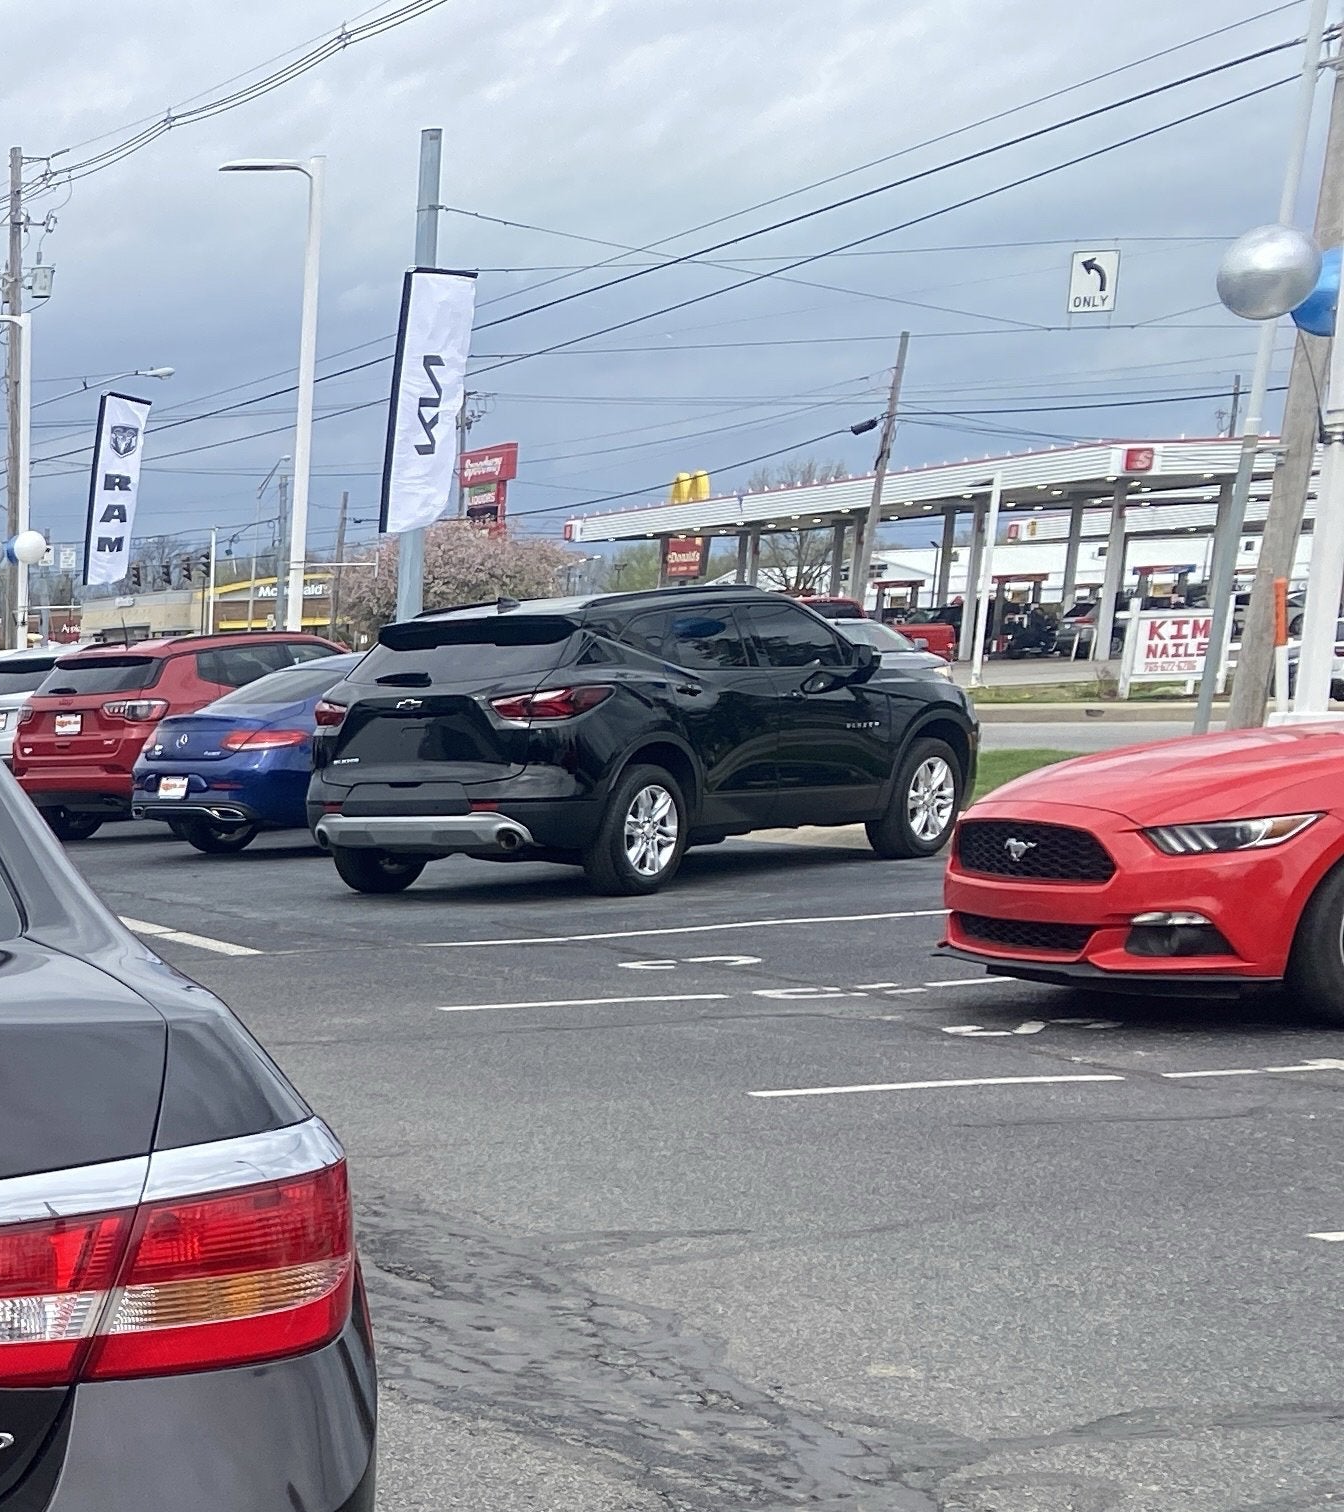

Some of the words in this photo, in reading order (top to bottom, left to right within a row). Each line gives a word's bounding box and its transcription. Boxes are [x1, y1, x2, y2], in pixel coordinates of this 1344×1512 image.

[1073, 294, 1109, 308] ONLY
[96, 473, 132, 552] RAM
[1148, 619, 1211, 641] KIM
[1146, 642, 1209, 659] NAILS
